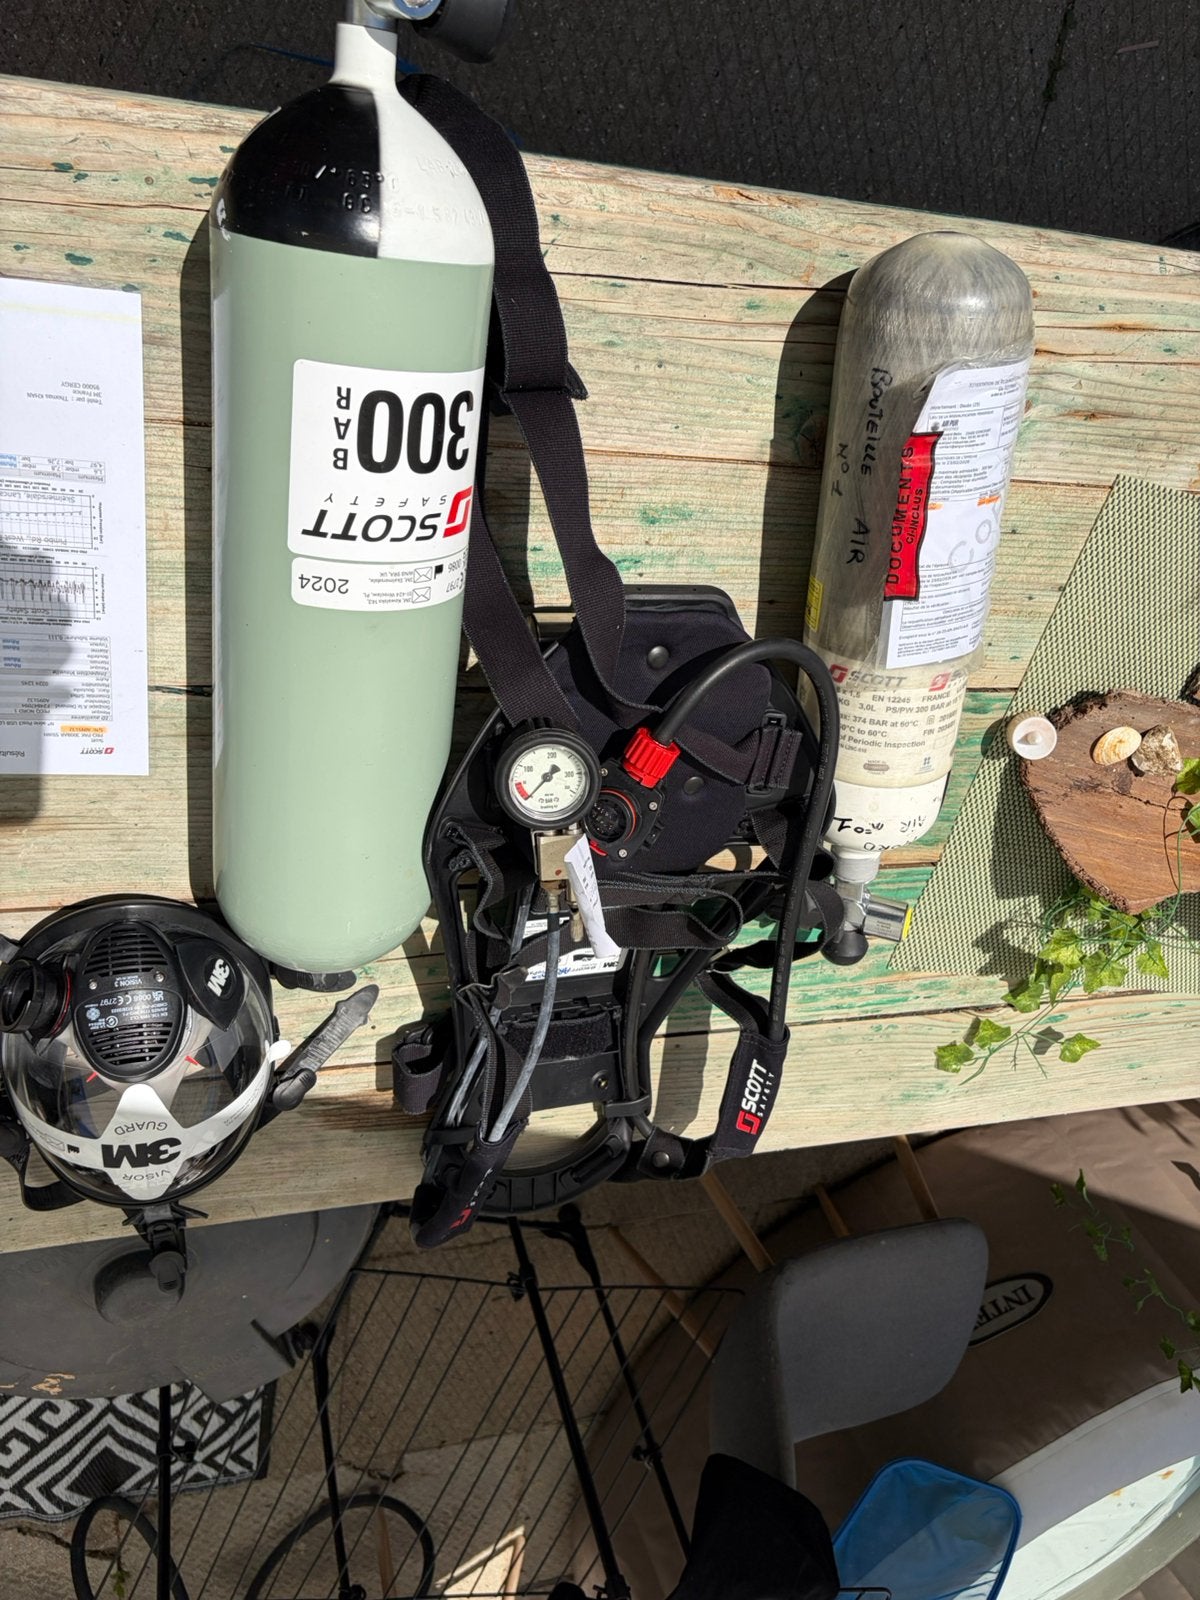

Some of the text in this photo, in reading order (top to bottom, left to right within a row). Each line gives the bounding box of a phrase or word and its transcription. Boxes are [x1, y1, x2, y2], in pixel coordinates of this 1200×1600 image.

[356, 390, 474, 475] 300
[324, 492, 448, 508] SAFETY
[886, 446, 914, 585] DOCUMENTS
[906, 488, 924, 545] CI-INCLUS
[300, 509, 442, 543] SCOTT
[846, 518, 870, 565] AIR
[298, 574, 349, 595] 2024
[848, 670, 908, 688] SCOTT
[872, 694, 884, 702] EN
[922, 691, 951, 702] FRANCE
[858, 702, 876, 712] 3,0L
[930, 702, 945, 712] BAR
[852, 716, 866, 724] 374
[868, 718, 888, 727] BAR
[848, 736, 882, 748] Periodic
[885, 740, 926, 750] Inspection
[119, 978, 142, 987] VISION
[207, 959, 230, 997] 3M
[100, 997, 118, 1006] 2797
[741, 1058, 767, 1114] SCOTT
[114, 1120, 168, 1136] GUARD
[101, 1137, 182, 1168] 3M
[122, 1169, 171, 1181] VISOR
[973, 1283, 1035, 1331] INTE
